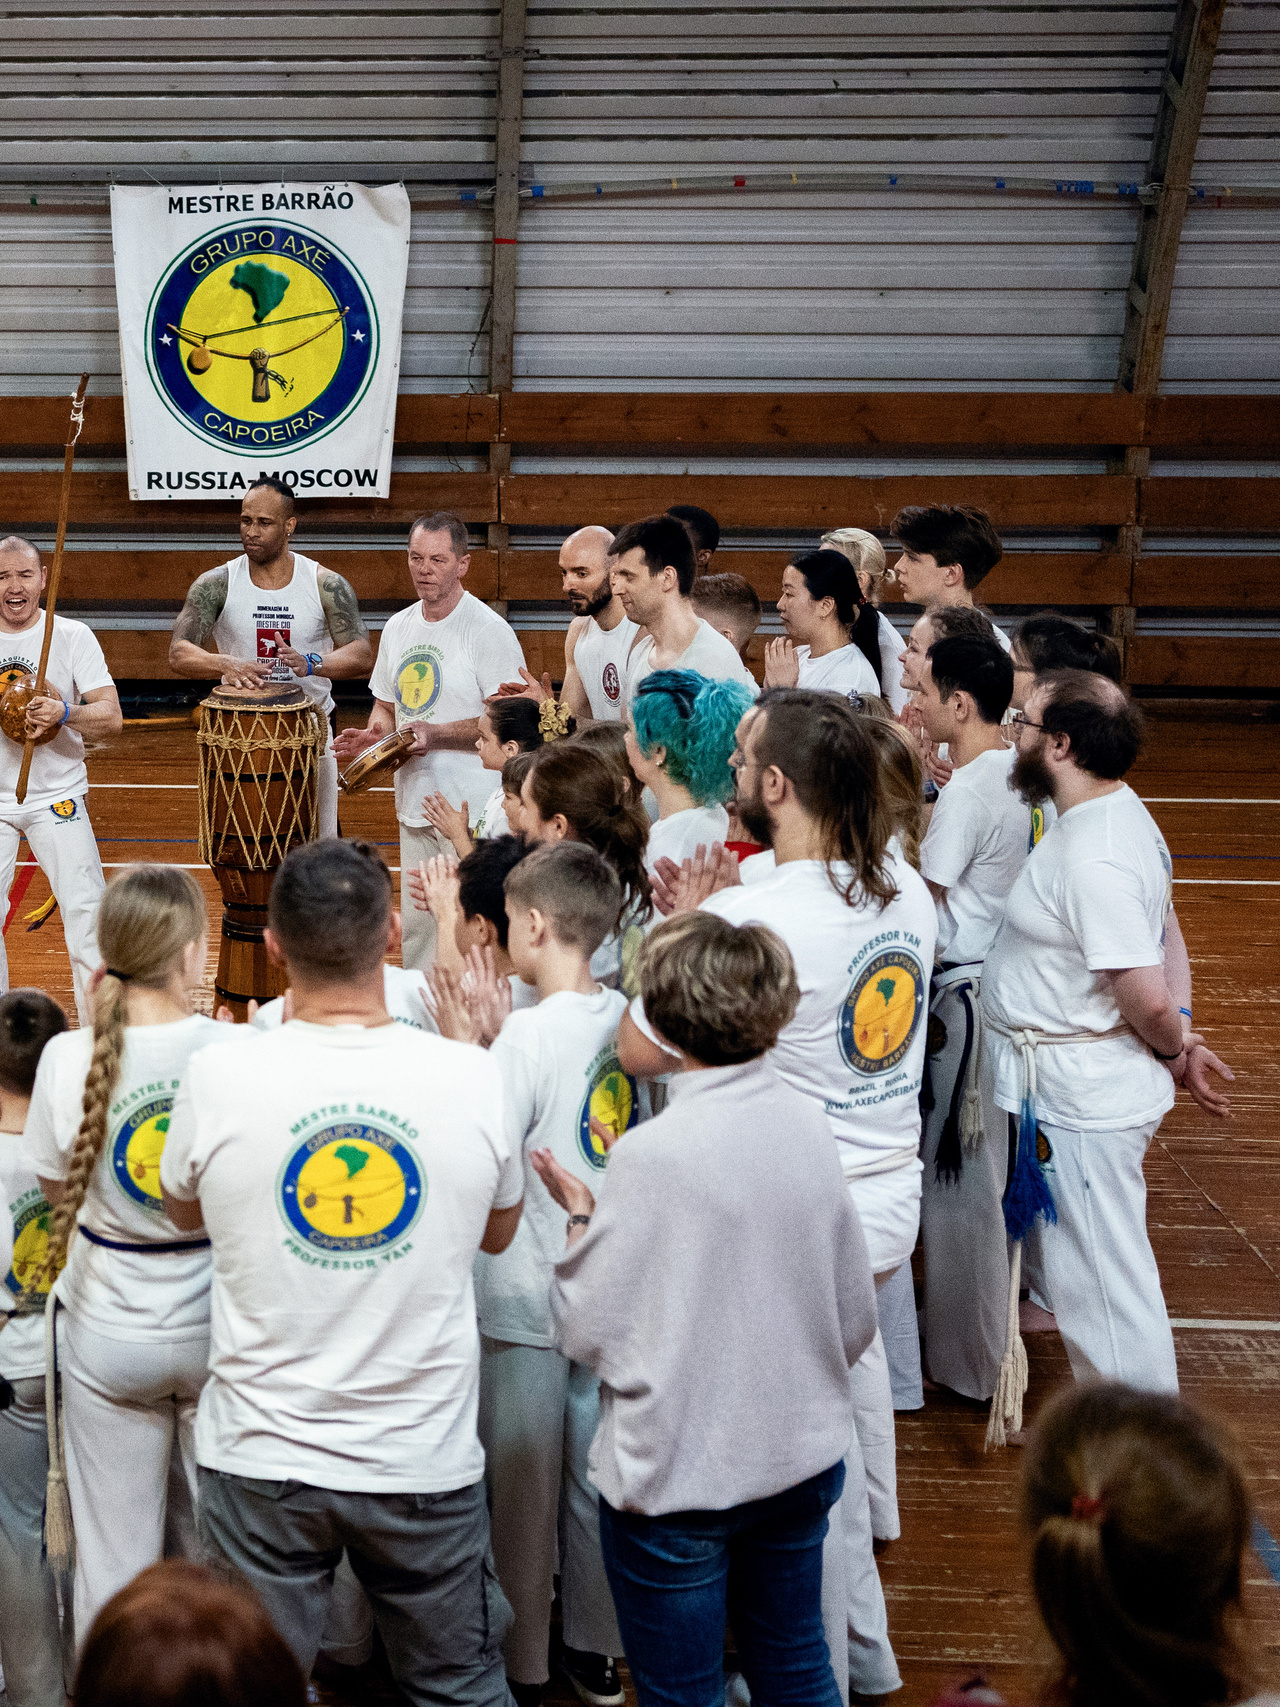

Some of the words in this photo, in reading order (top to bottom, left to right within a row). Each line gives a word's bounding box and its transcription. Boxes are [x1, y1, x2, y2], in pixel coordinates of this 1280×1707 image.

[168, 194, 254, 214] MESTRE
[261, 185, 354, 211] BARRÃO
[190, 230, 275, 275] GRUPO
[282, 235, 331, 271] AXÉ
[204, 410, 325, 443] CAPOEIRA
[847, 930, 900, 975] PROFESSOR
[903, 930, 922, 948] YAN
[112, 1081, 166, 1115] MESTRE
[848, 1083, 877, 1095] BRAZIL
[290, 1103, 348, 1136] MESTRE
[306, 1124, 363, 1152] GRUPO
[283, 1238, 377, 1270] PROFESSOR
[381, 1242, 413, 1263] YAN
